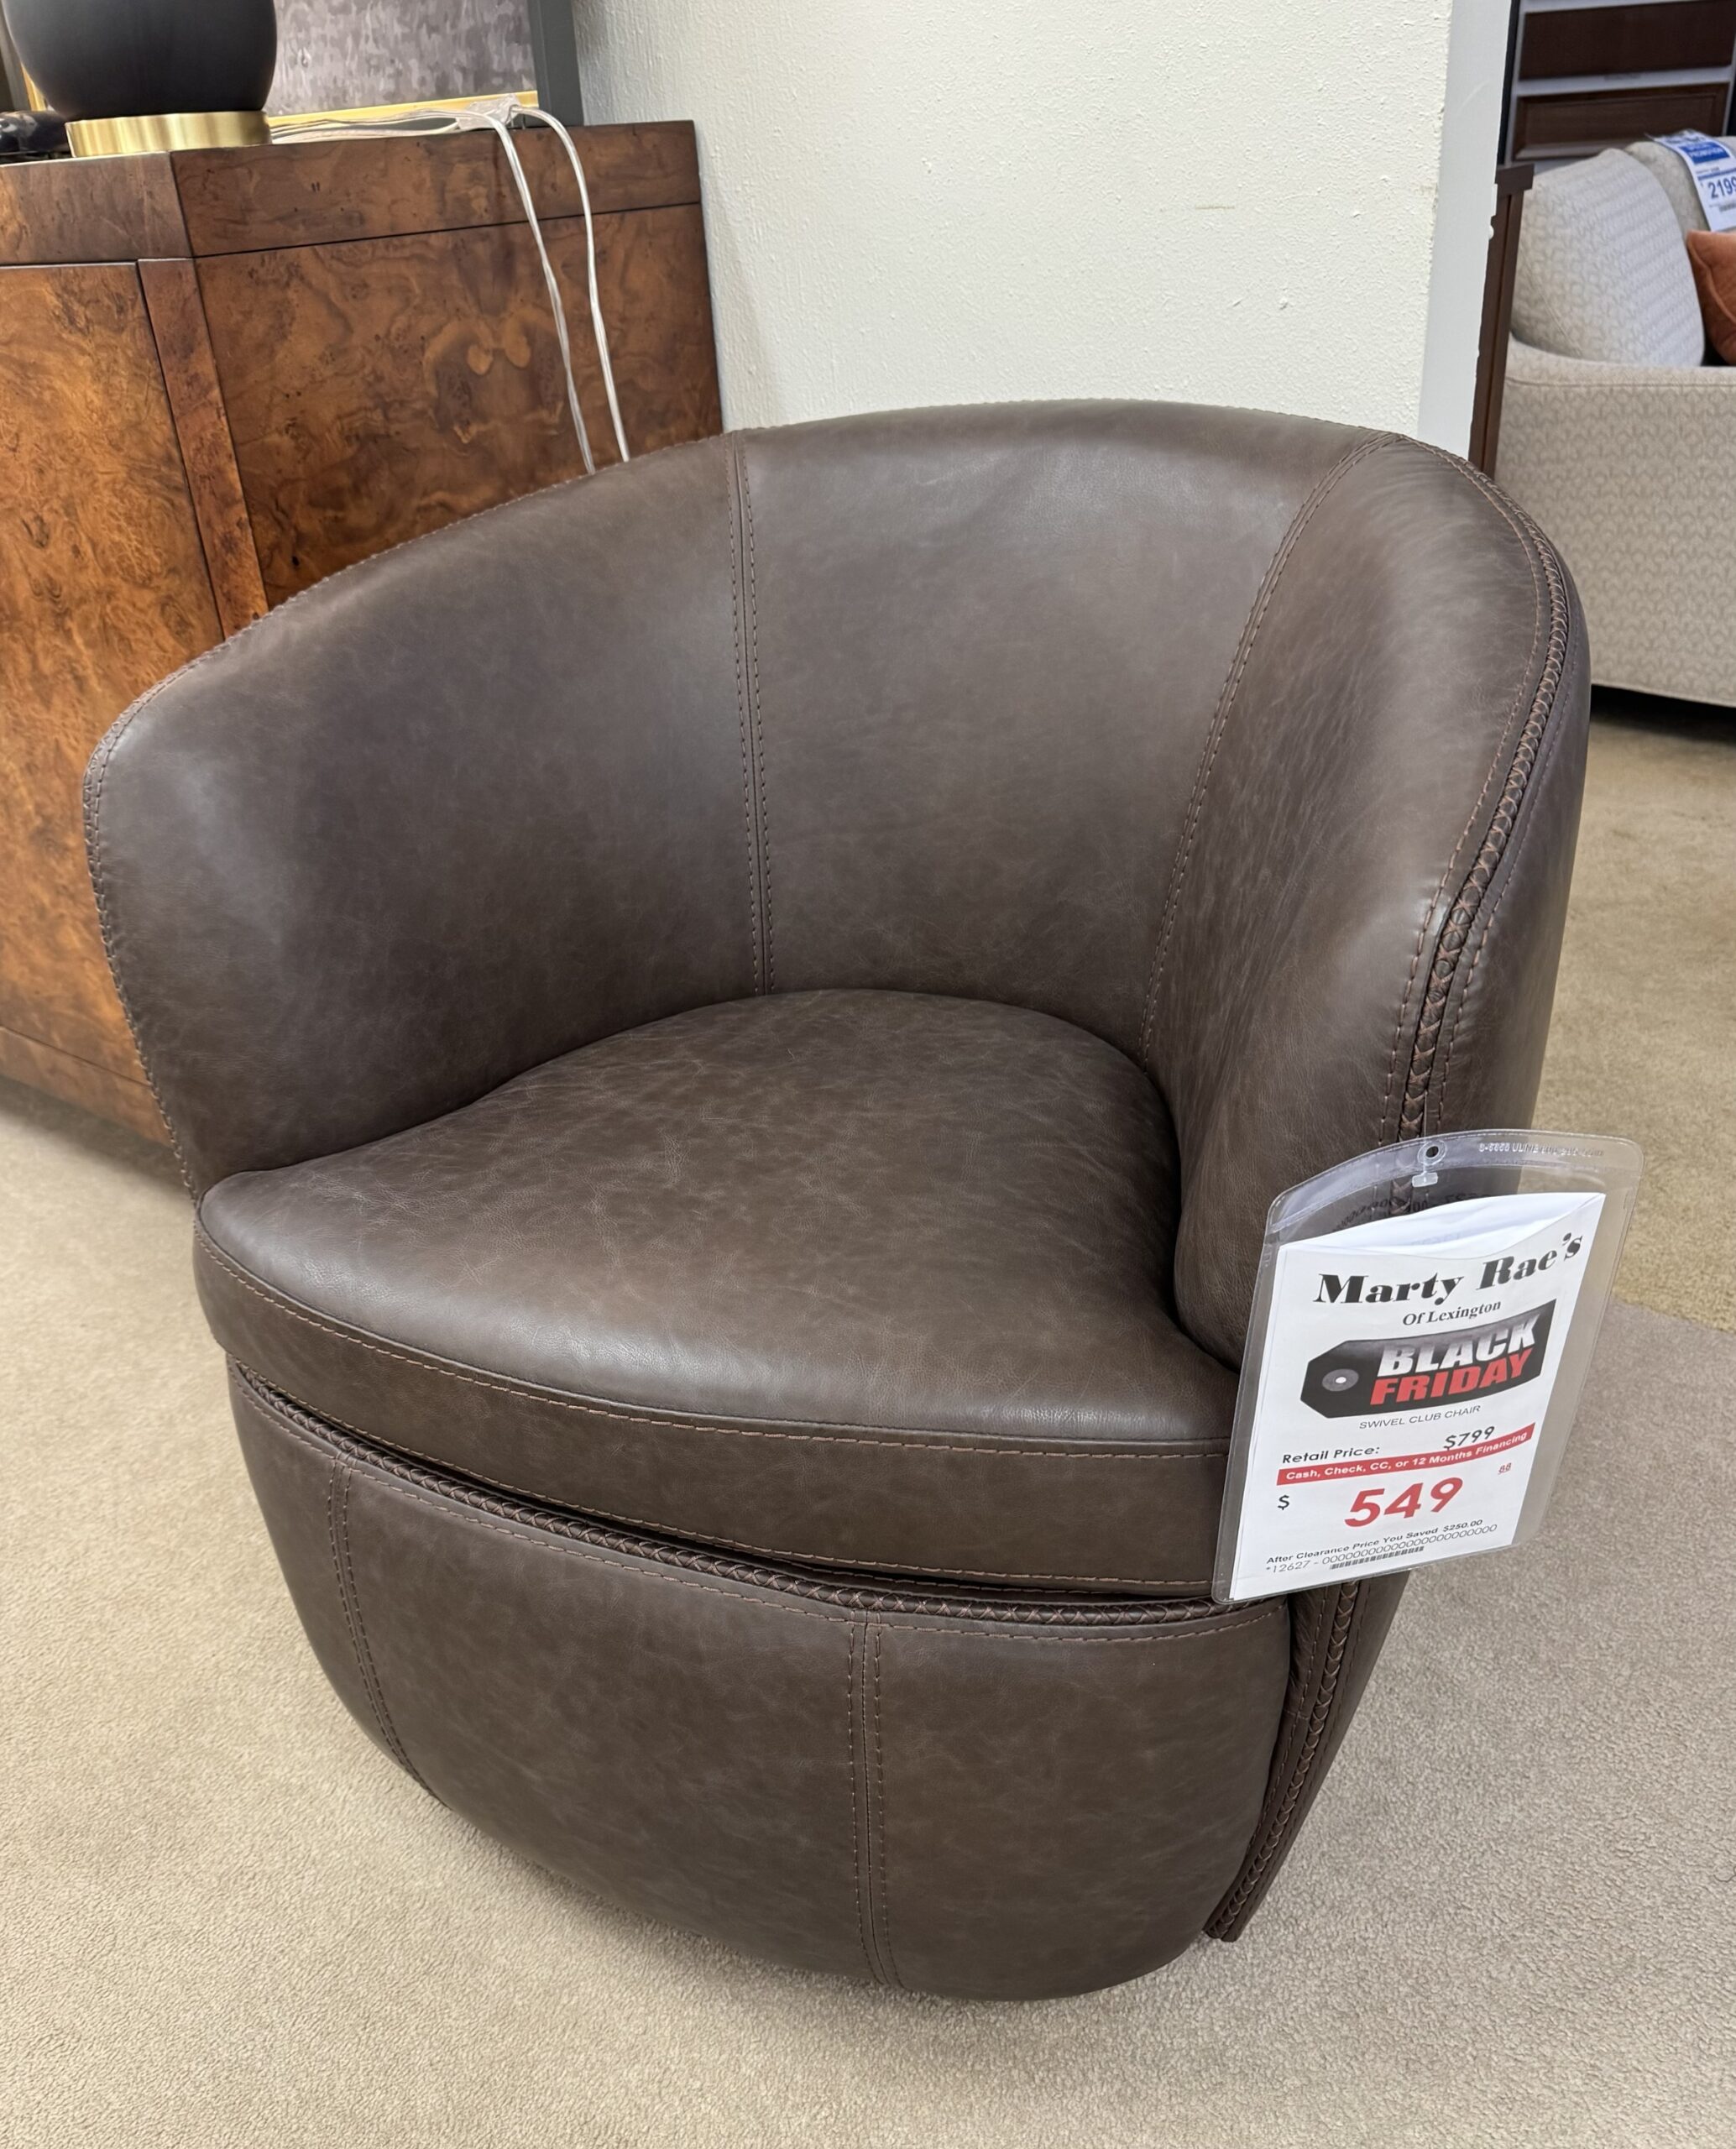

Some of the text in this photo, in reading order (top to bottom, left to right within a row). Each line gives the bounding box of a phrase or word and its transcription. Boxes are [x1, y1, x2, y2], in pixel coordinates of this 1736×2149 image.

[1313, 1232, 1582, 1305] Marty Rae's
[1403, 1301, 1501, 1325] Of Lexington
[1377, 1313, 1540, 1377] BLACK
[1370, 1348, 1533, 1405] FRIDAY
[1359, 1405, 1481, 1430] SWIVEL CLUB CHAIR
[1282, 1426, 1495, 1464] Retail Price: $799
[1285, 1431, 1527, 1481] Cash, Check, CC, or 12 Months Financing
[1278, 1477, 1463, 1527] $ 549
[1266, 1519, 1483, 1564] After Clearance Price You Saved $250.00
